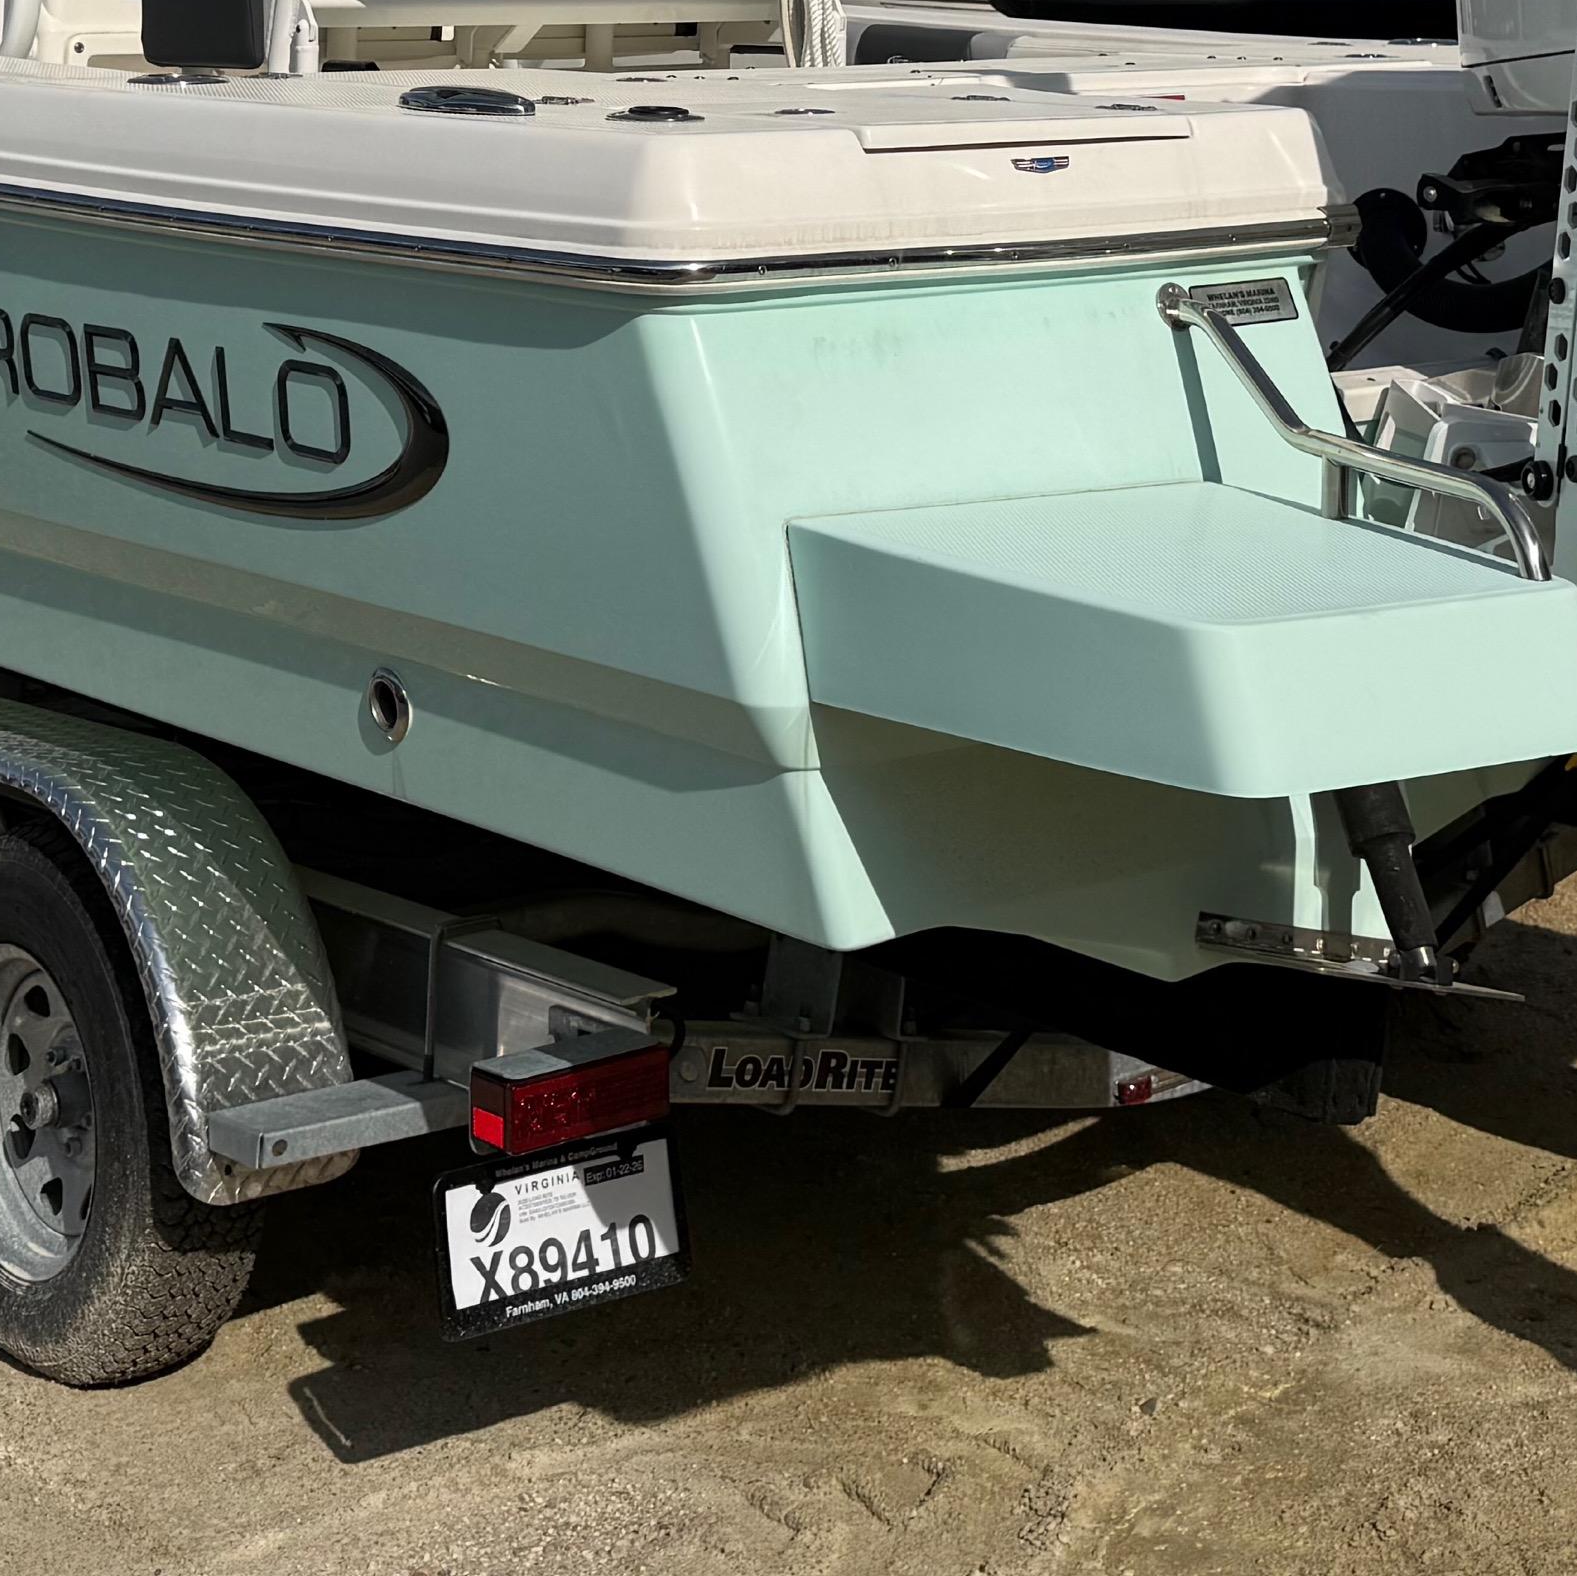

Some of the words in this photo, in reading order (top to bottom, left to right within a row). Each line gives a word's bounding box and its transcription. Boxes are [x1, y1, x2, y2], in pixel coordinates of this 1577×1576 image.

[514, 1170, 580, 1196] VIRGINIA
[470, 1213, 656, 1305] X89410
[505, 1298, 554, 1318] Farnham,
[555, 1293, 570, 1305] VA
[571, 1274, 637, 1302] 804-394-9500
